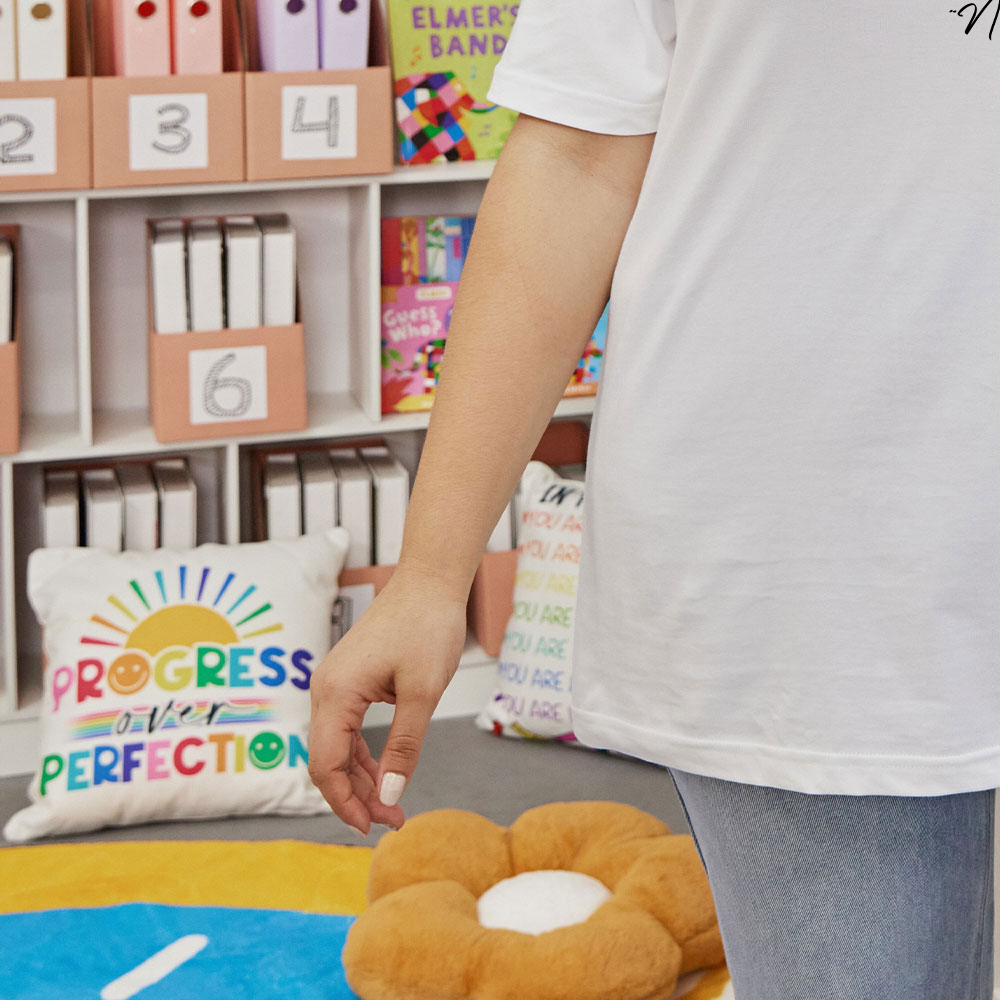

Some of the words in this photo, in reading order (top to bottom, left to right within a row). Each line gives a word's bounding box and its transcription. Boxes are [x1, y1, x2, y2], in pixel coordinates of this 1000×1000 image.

[430, 34, 508, 58] BAND
[0, 113, 34, 163] 2
[152, 103, 191, 154] 3
[291, 95, 338, 148] 4
[383, 305, 438, 328] Guess
[388, 319, 442, 343] Who?
[203, 352, 250, 417] 6
[53, 646, 313, 712] PROGRESS
[115, 699, 228, 735] over
[39, 731, 309, 796] PERFECTION
